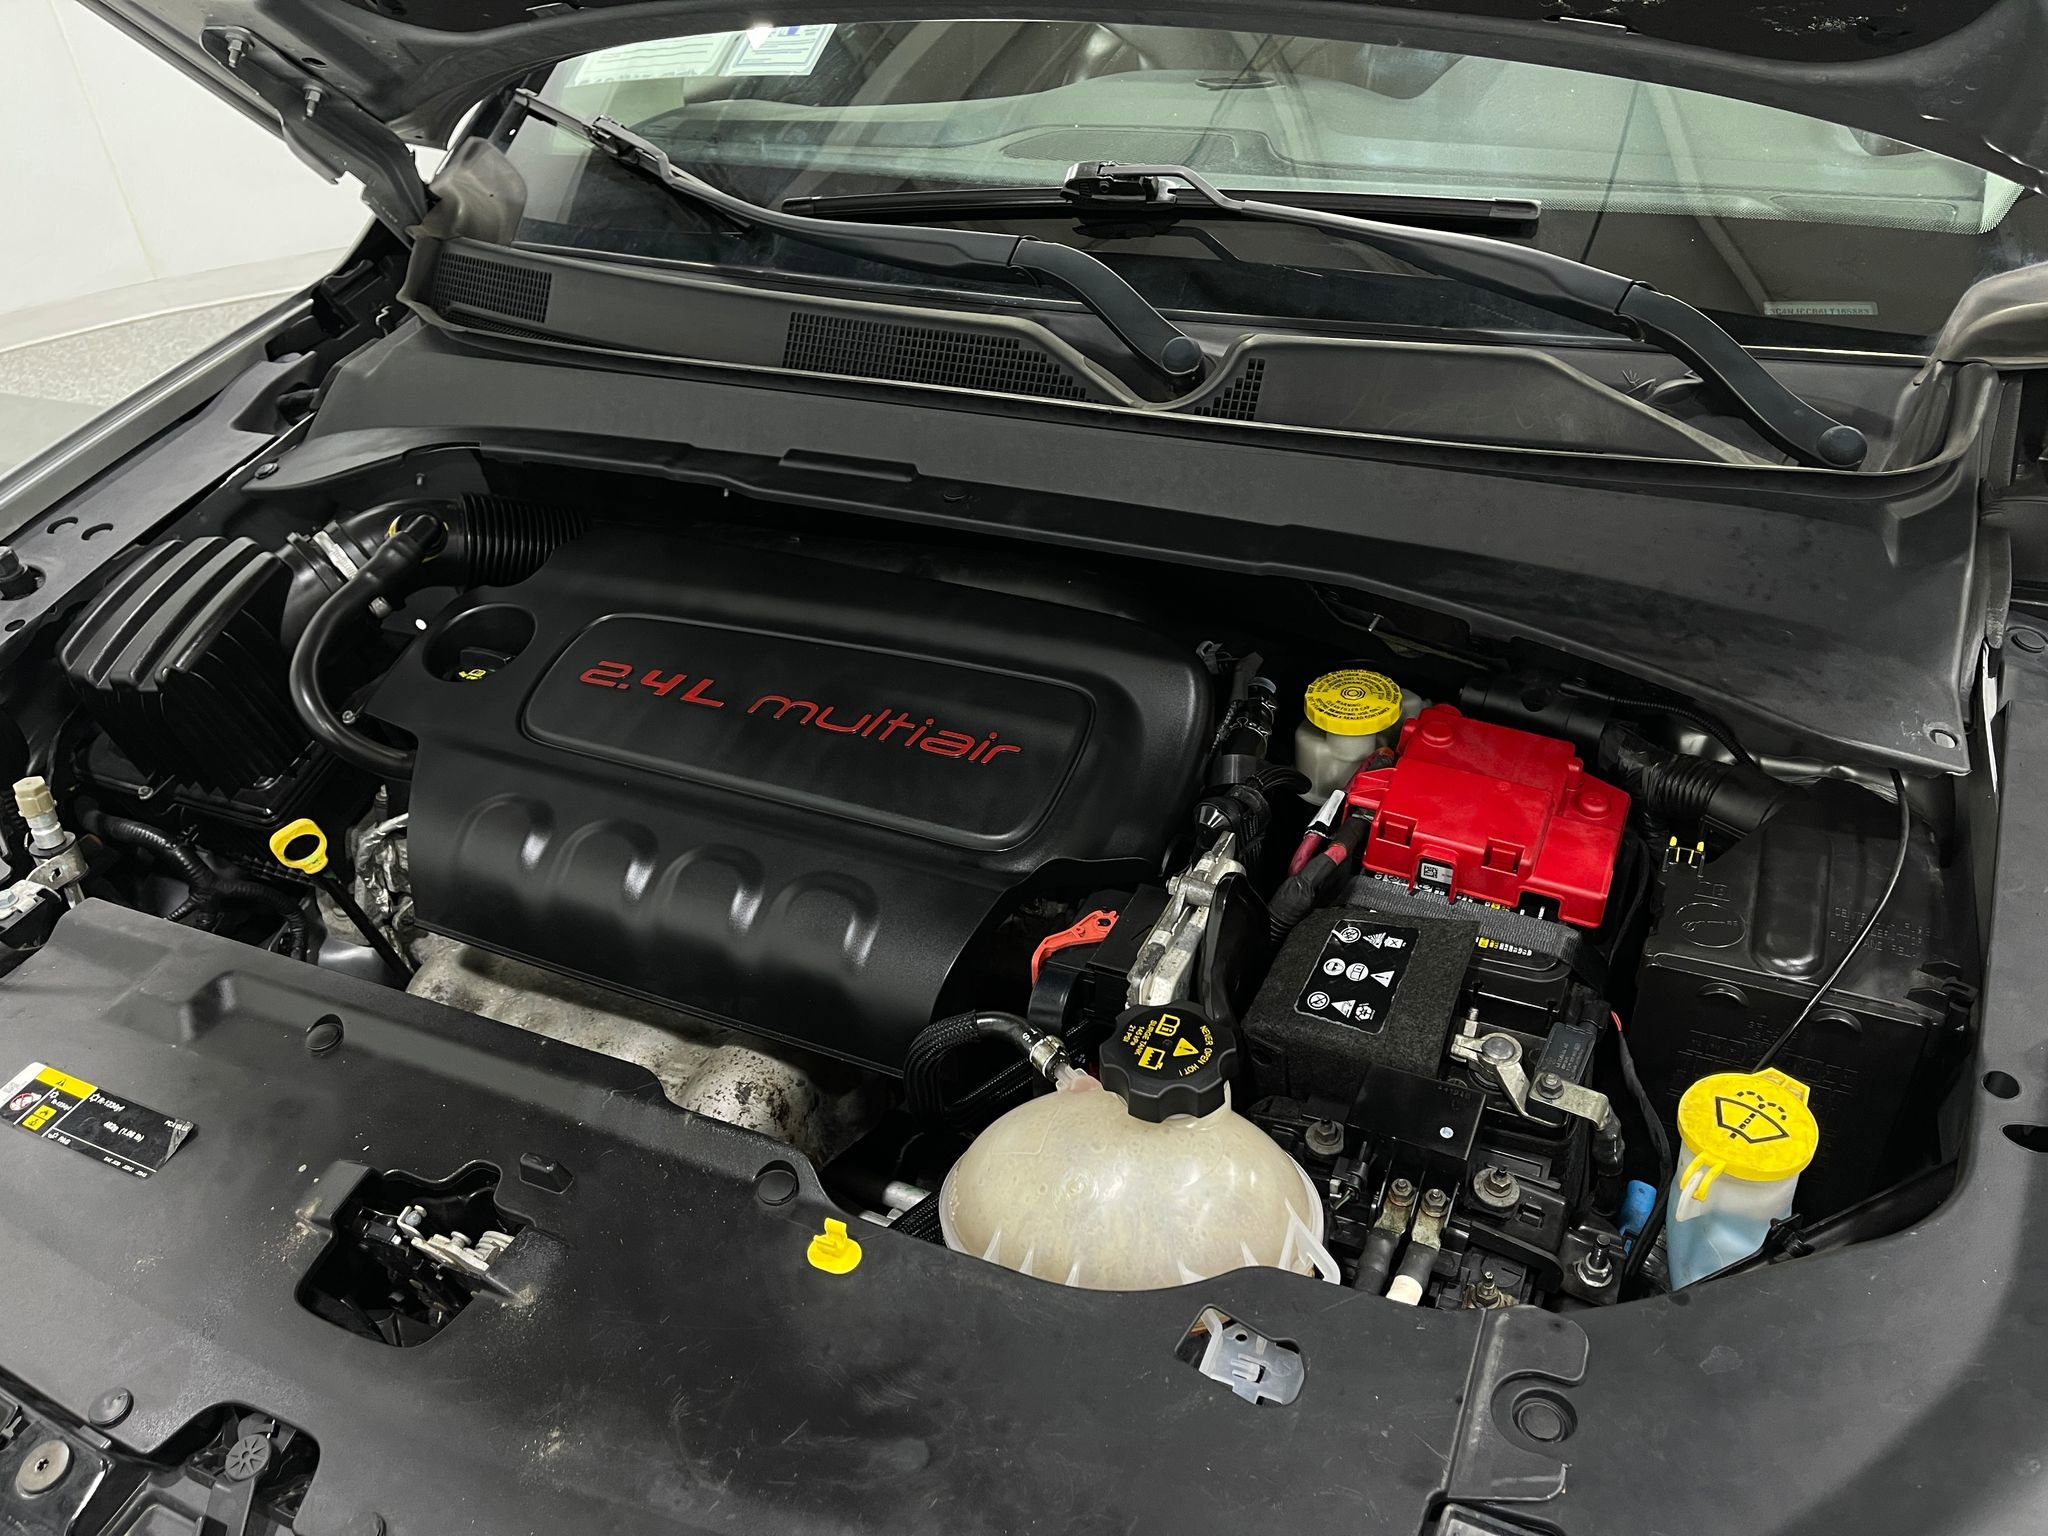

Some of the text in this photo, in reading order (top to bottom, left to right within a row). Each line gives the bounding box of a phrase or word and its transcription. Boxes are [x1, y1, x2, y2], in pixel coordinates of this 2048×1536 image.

[578, 660, 1023, 765] 2.4L multiair
[1127, 1024, 1136, 1033] 21
[1133, 1019, 1158, 1056] SURGE TANK
[1199, 1025, 1214, 1047] NEVER
[1197, 1047, 1213, 1065] OPEN
[97, 1095, 126, 1113] R-1234yf
